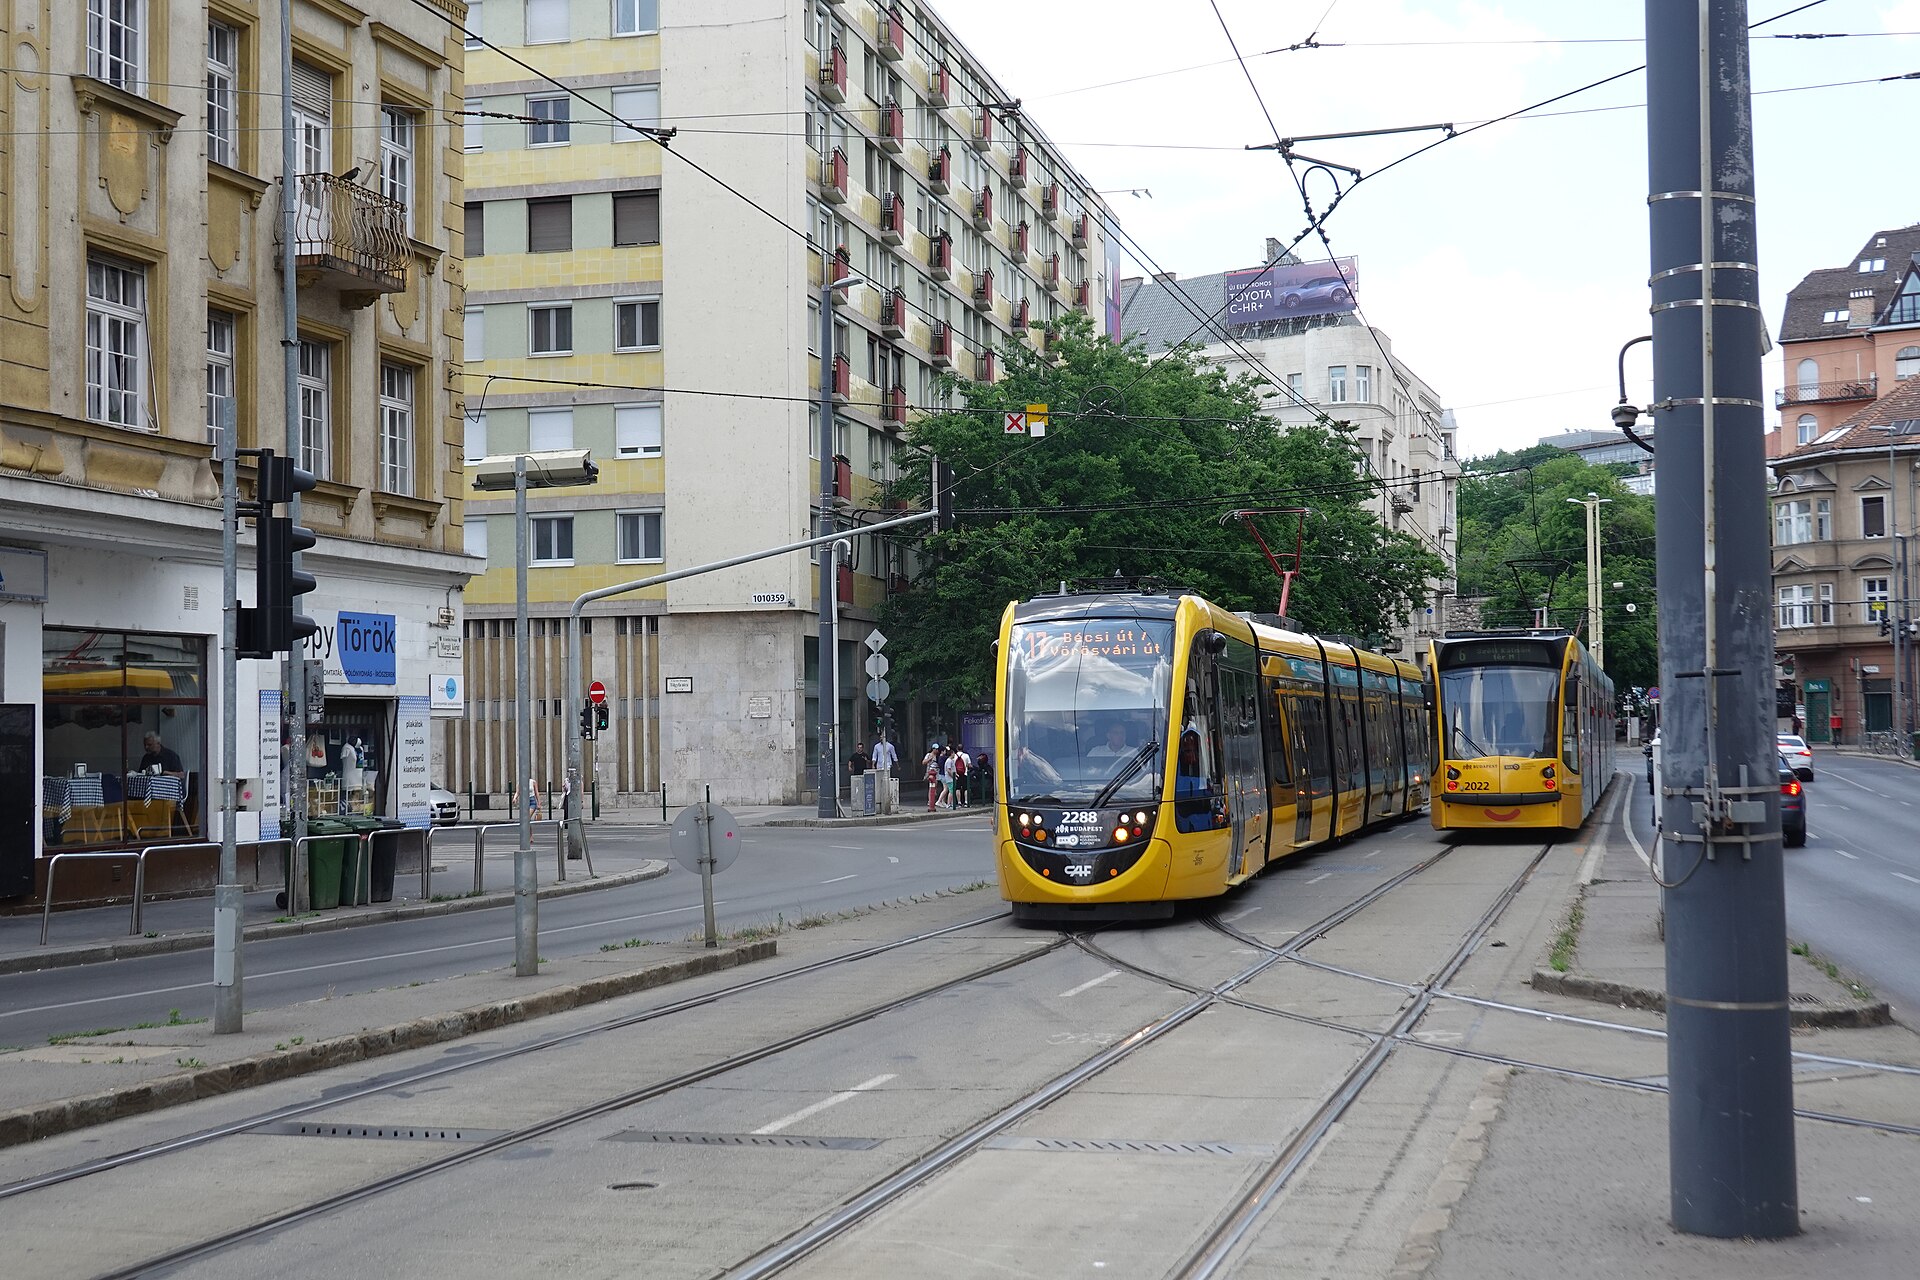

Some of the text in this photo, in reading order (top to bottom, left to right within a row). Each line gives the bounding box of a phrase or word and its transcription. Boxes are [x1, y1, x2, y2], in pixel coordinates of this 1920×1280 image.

[1236, 281, 1272, 290] ELEROMOS
[1230, 290, 1272, 303] TOYOTA
[1230, 302, 1264, 314] C-HR+
[753, 594, 785, 602] 1010359
[340, 619, 395, 653] Török
[1025, 631, 1047, 659] 17
[1063, 632, 1109, 643] Bécsi
[1117, 630, 1133, 642] út
[1143, 643, 1160, 654] út
[1459, 649, 1466, 661] 6
[346, 669, 373, 677] PÓLÓNYOMÁS
[405, 720, 423, 728] plakátok
[405, 737, 424, 746] meghívók
[405, 754, 424, 764] egyszerű
[403, 765, 425, 774] kiadványok
[1464, 781, 1489, 790] 2022
[1061, 811, 1098, 823] 2288
[1064, 865, 1092, 877] CAF
